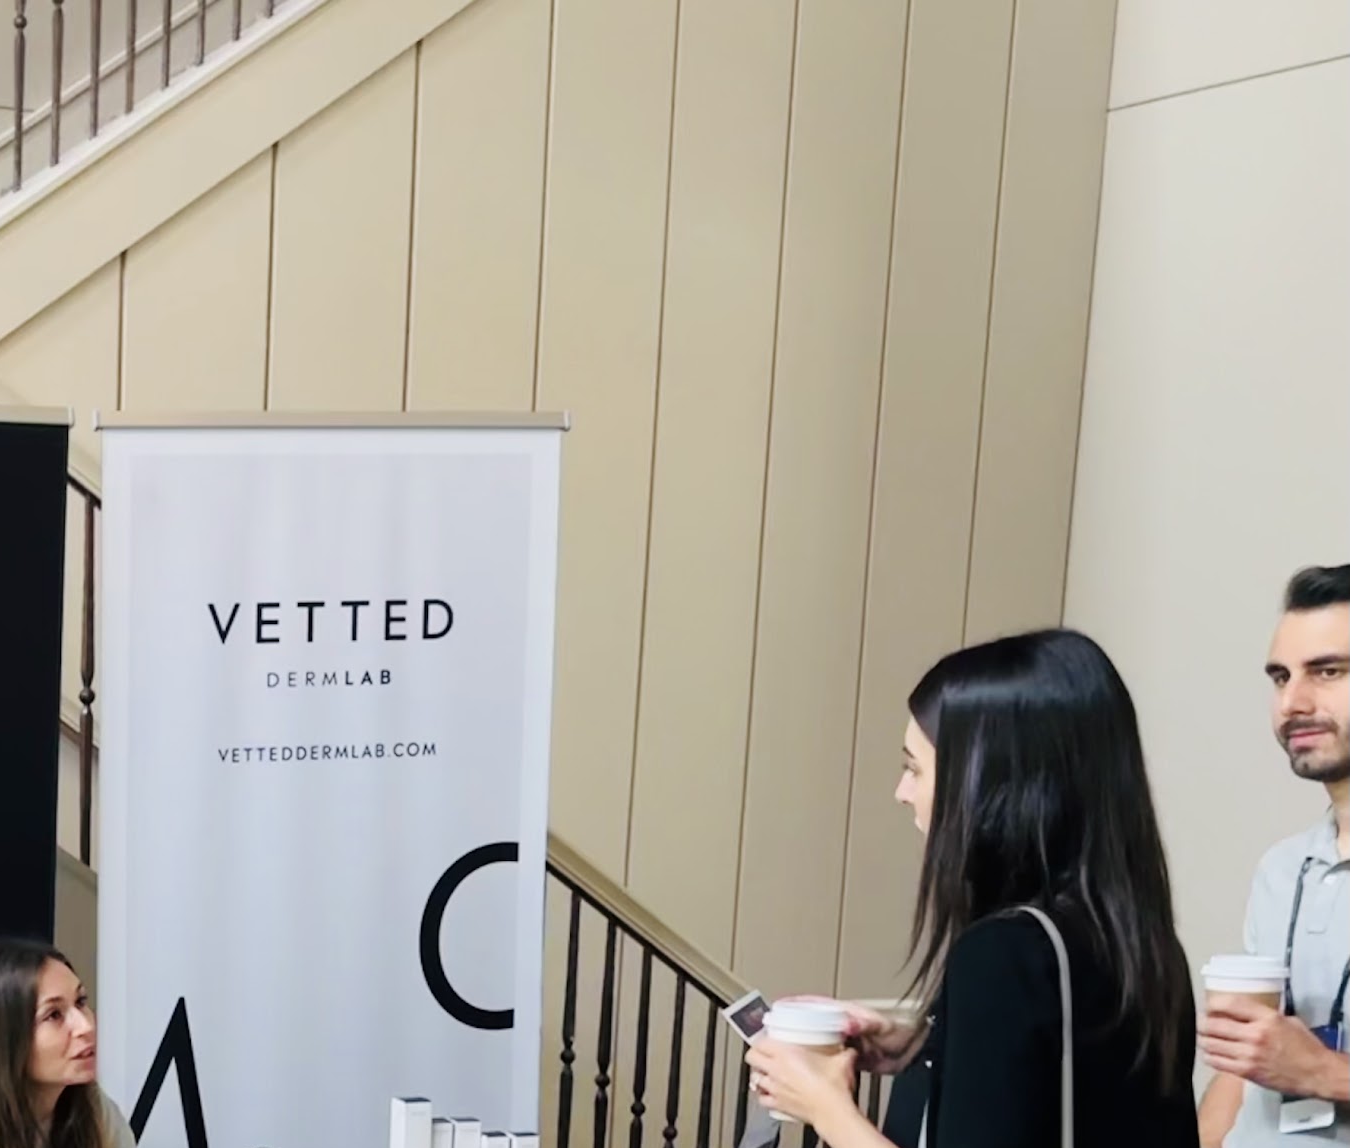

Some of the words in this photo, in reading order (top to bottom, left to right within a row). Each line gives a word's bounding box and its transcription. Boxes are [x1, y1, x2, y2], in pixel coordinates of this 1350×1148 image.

[207, 599, 454, 644] VETTED
[267, 669, 391, 687] DERMLAB
[218, 742, 437, 763] VETTEDDERMLAB.COM
